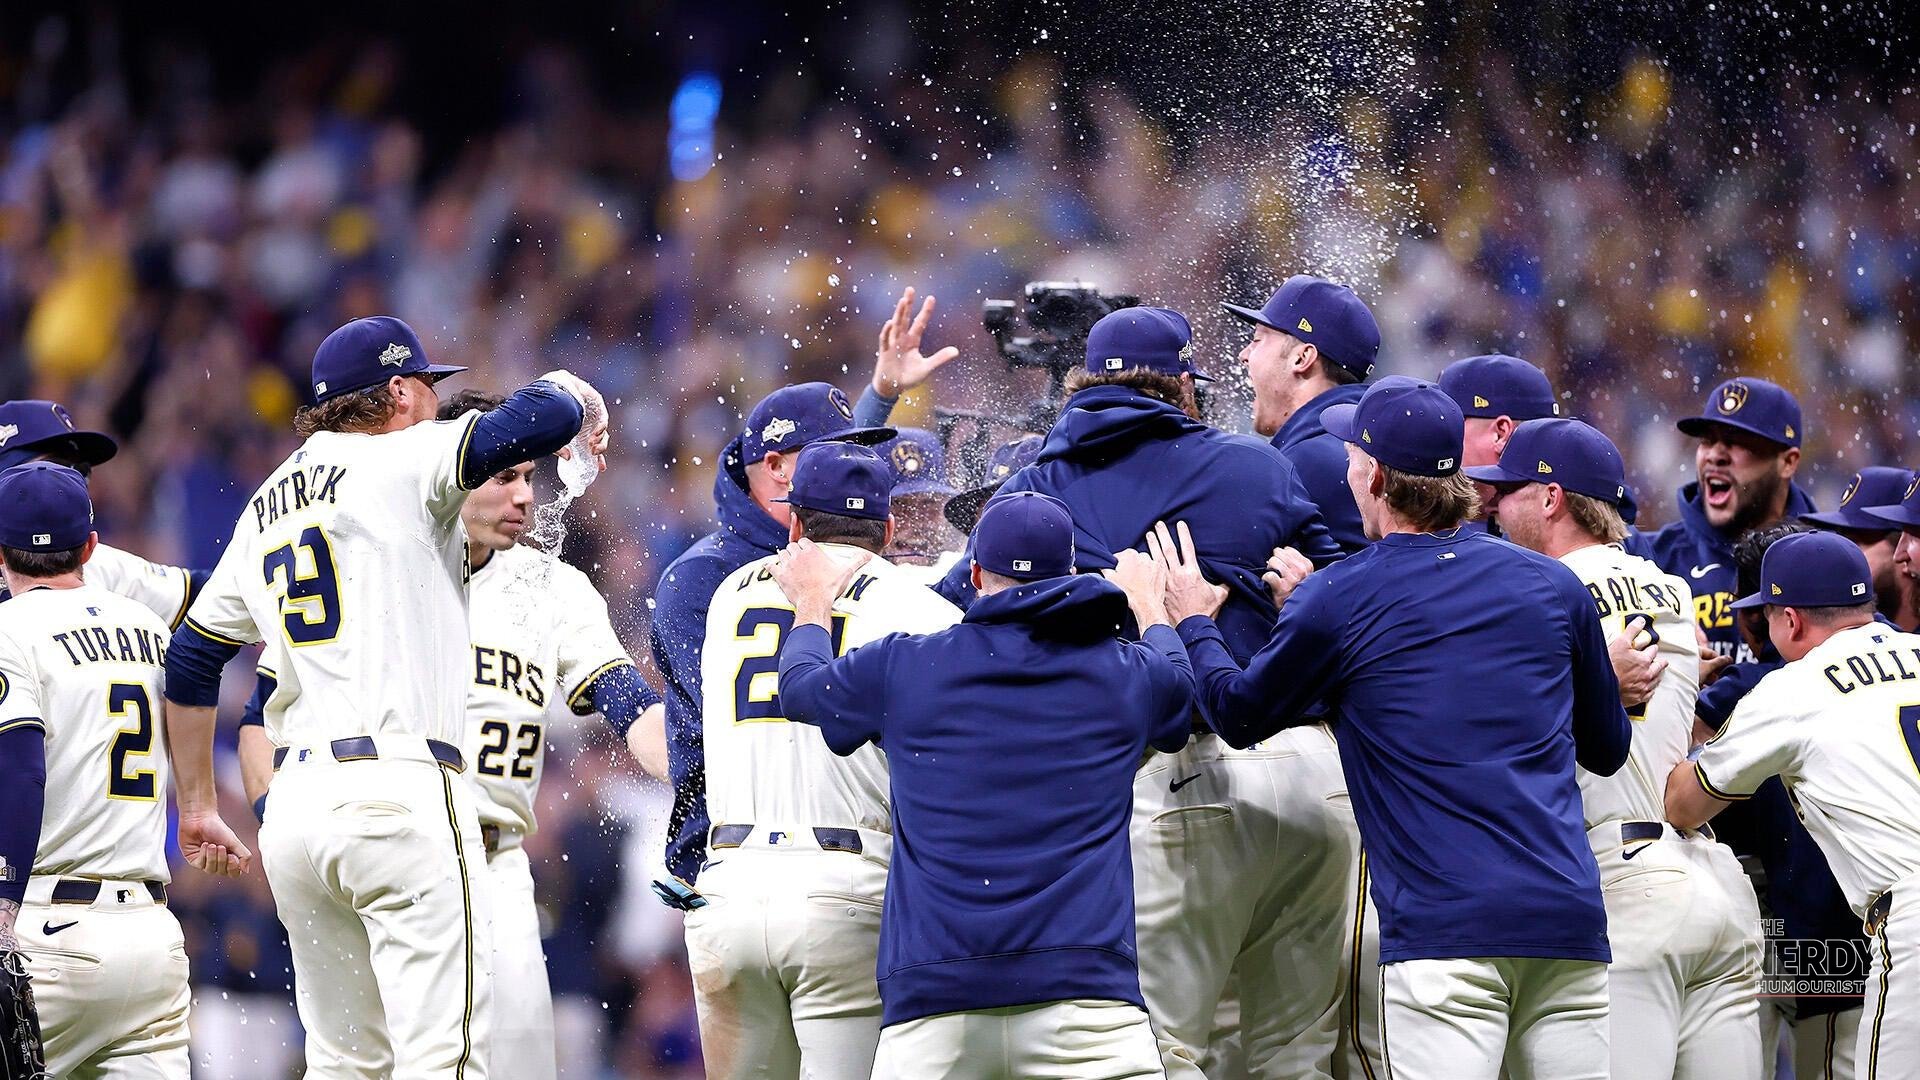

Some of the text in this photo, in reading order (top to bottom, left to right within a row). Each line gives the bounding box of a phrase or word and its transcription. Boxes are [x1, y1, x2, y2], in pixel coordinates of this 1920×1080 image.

[253, 464, 347, 534] PATRCK
[1585, 576, 1681, 619] BAURS
[107, 681, 157, 800] 2
[477, 718, 542, 778] 22
